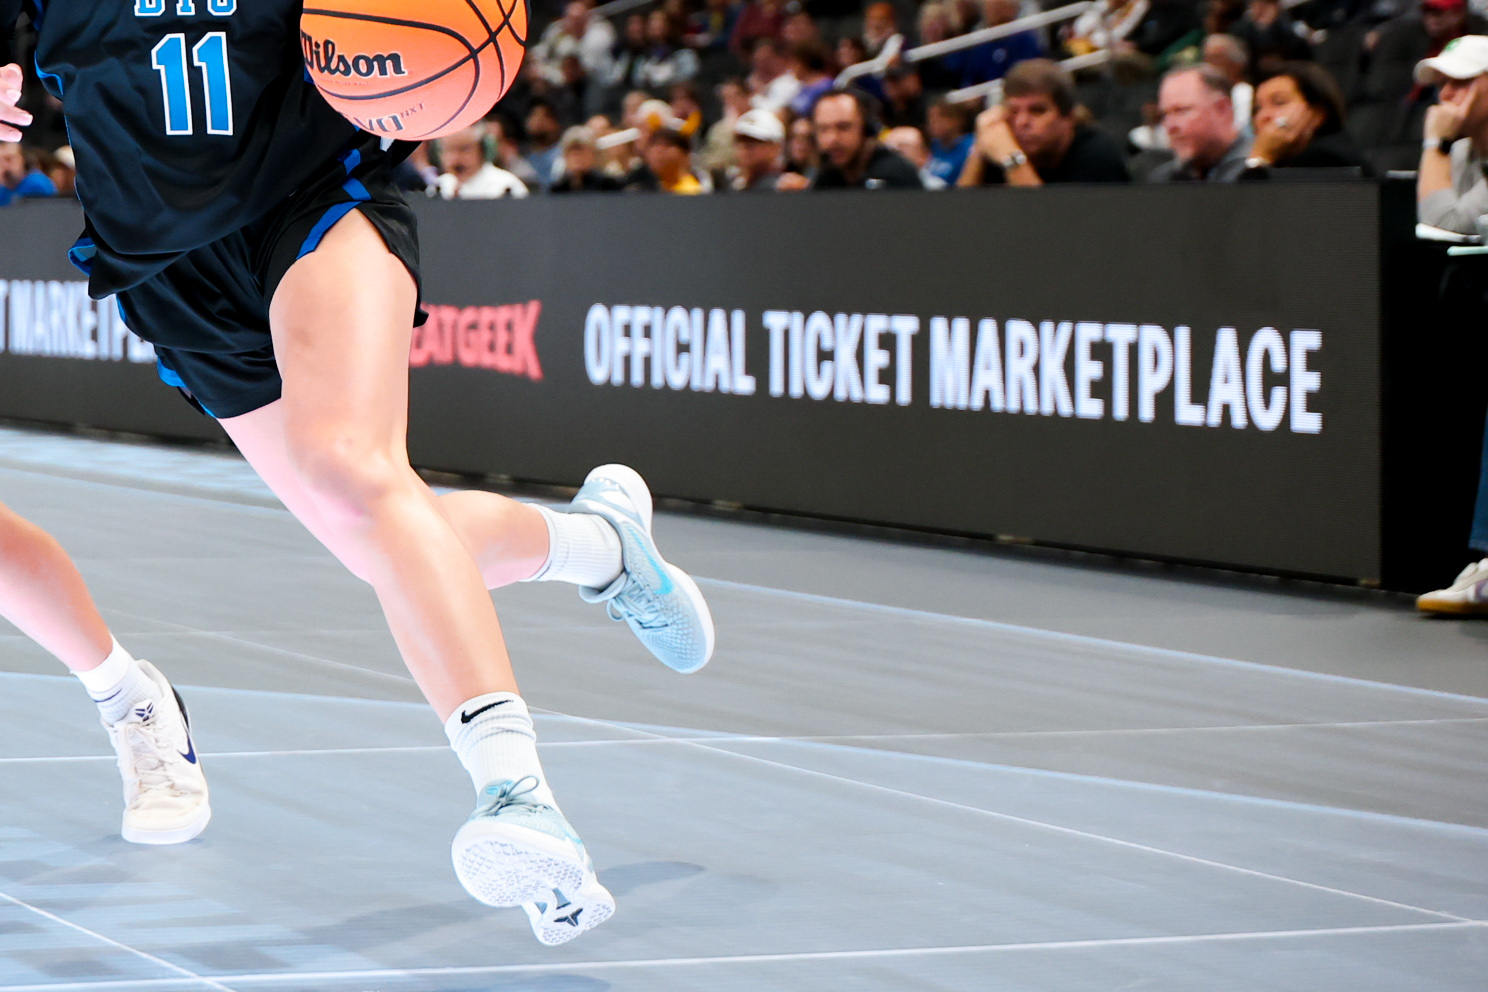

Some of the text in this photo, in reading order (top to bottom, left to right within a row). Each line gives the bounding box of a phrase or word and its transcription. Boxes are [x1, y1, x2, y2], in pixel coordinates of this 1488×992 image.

[151, 31, 234, 136] 11
[409, 299, 544, 382] EATGEEK
[583, 303, 1323, 435] OFFICIAL TICKET MARKETPLACE
